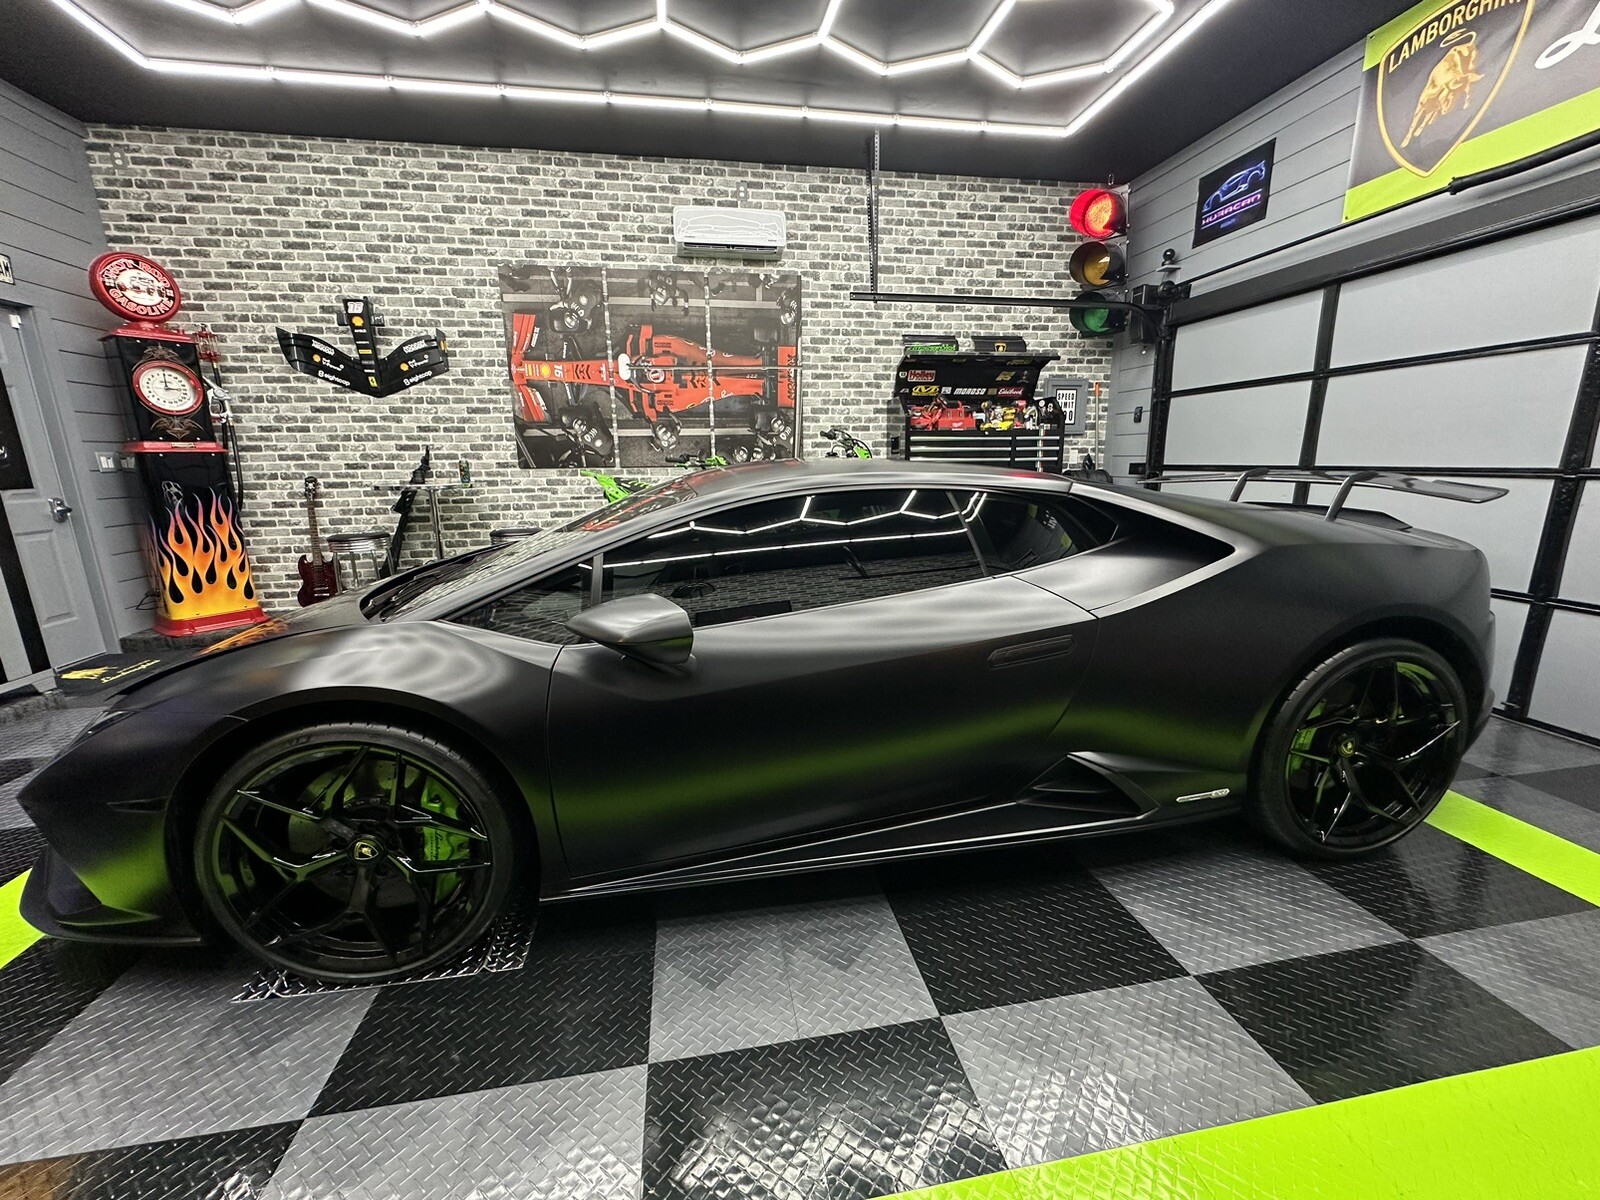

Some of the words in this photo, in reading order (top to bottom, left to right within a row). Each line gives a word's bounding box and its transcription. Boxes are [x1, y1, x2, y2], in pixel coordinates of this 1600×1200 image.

[1389, 0, 1520, 74] LAMBORGH
[139, 260, 171, 288] ROD
[108, 288, 174, 316] GASOLINE
[347, 301, 364, 314] 16
[909, 370, 935, 381] Holley
